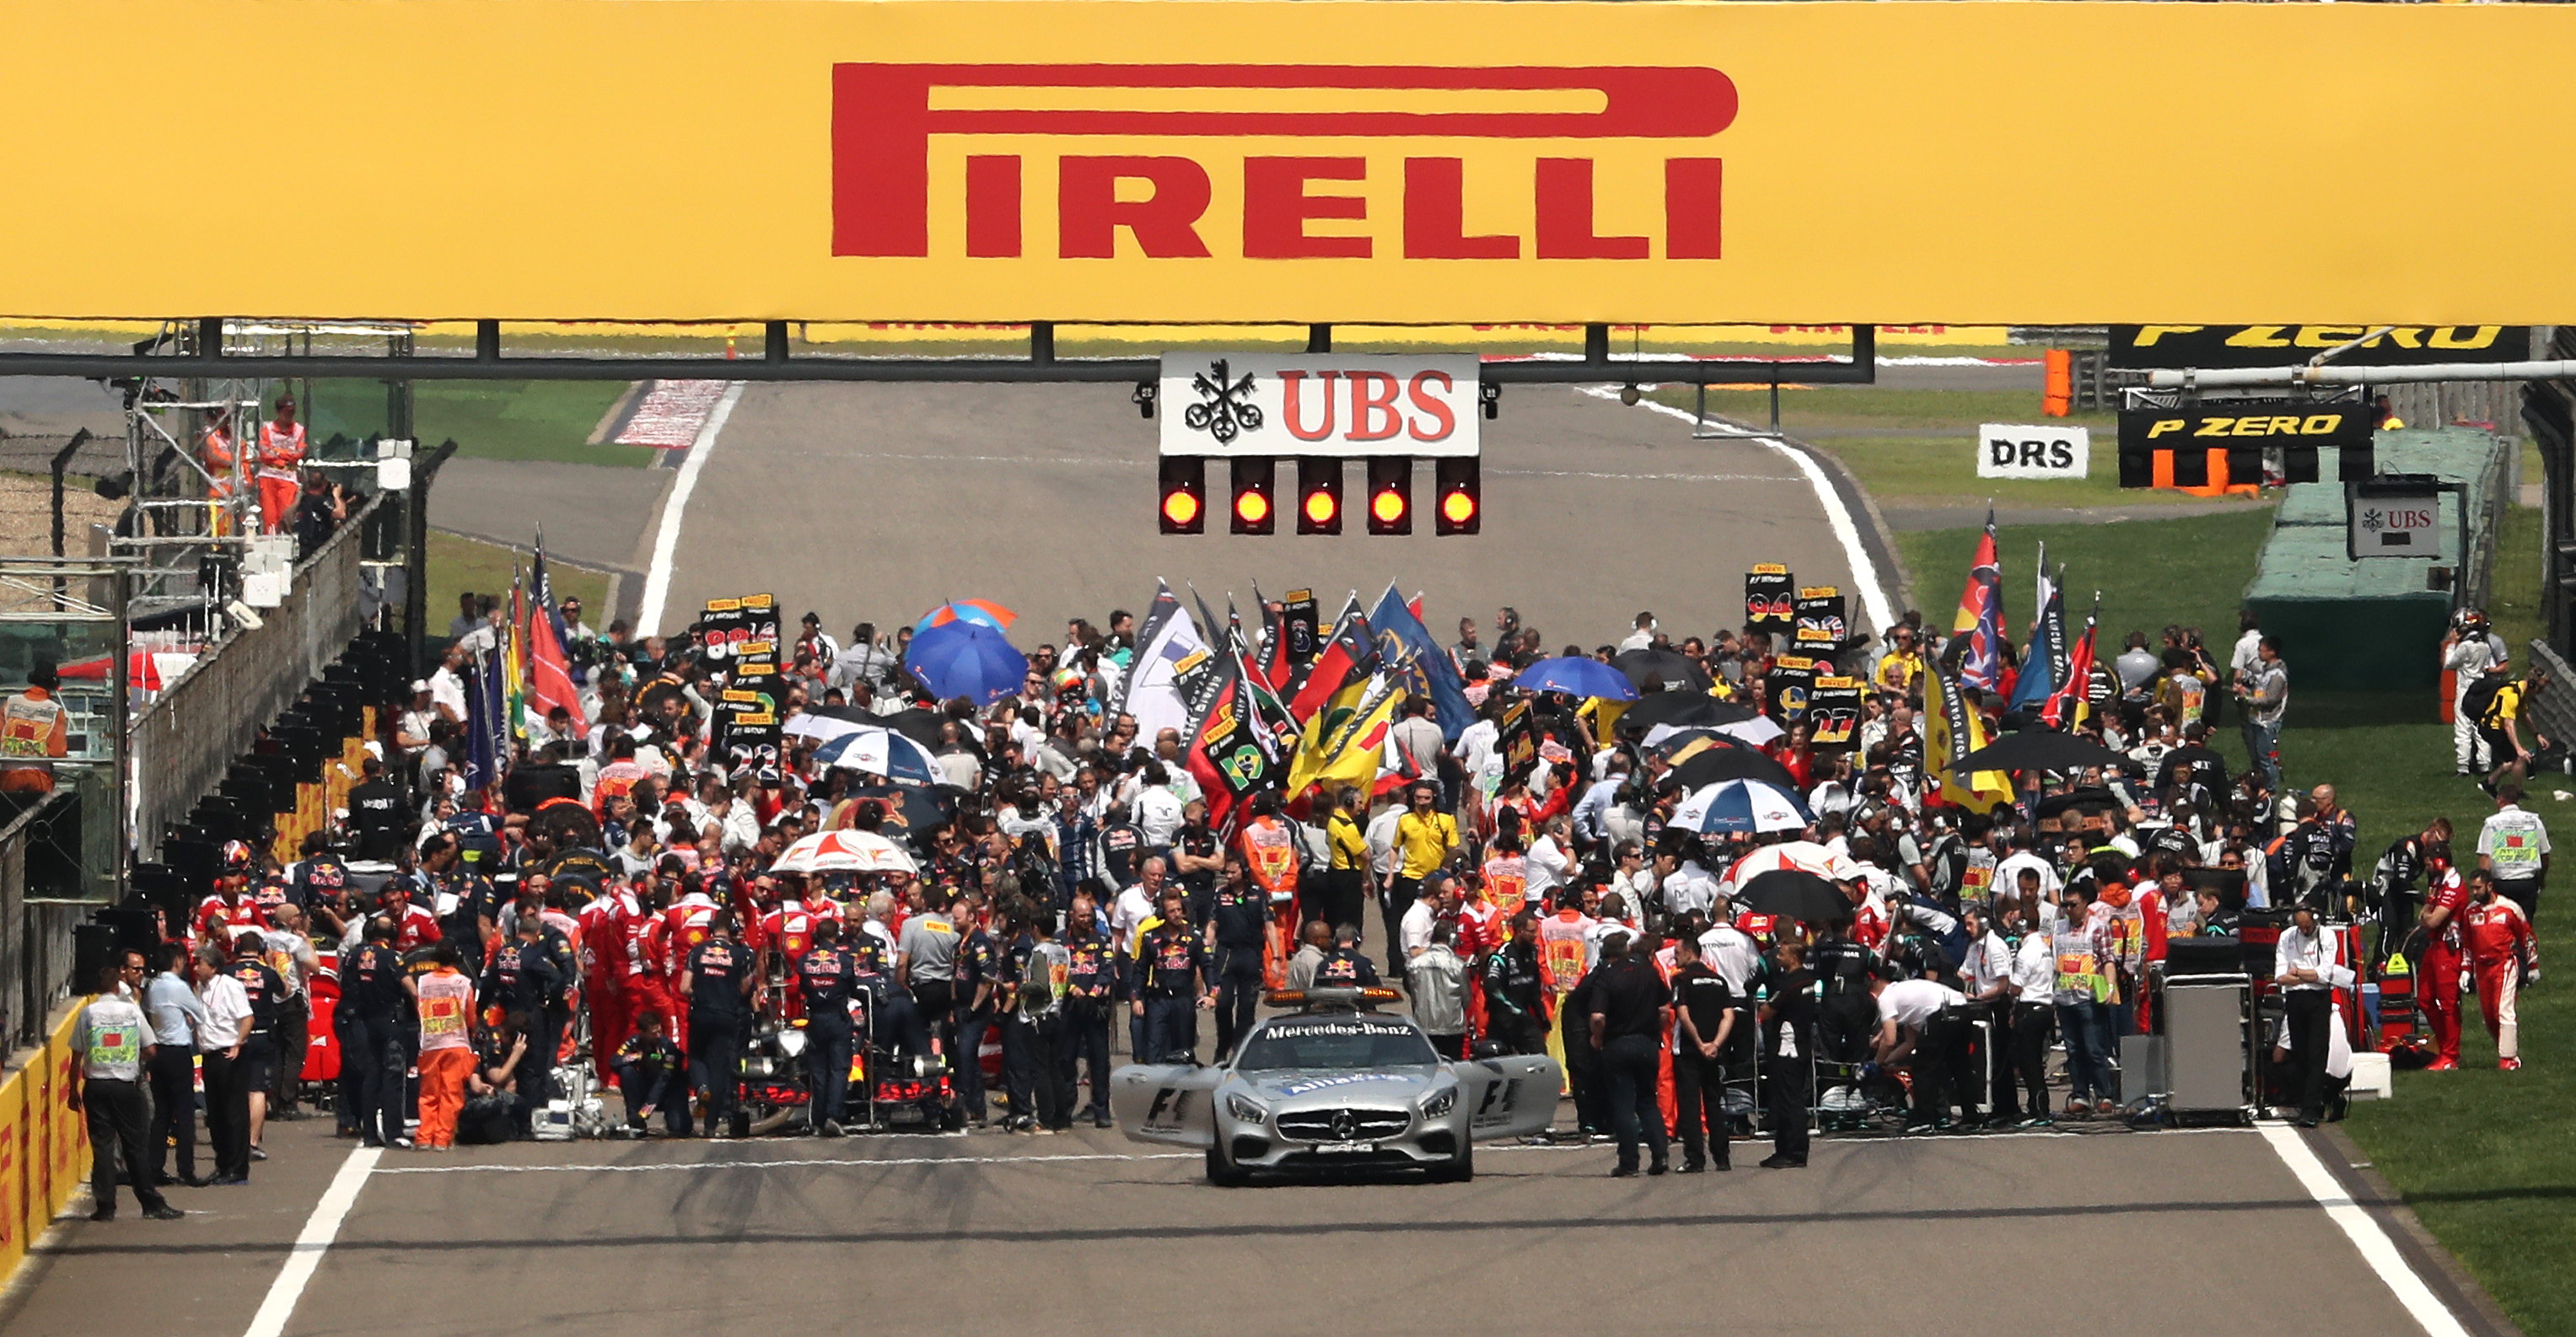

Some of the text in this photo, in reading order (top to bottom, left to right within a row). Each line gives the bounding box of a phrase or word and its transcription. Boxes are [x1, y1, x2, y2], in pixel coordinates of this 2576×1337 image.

[831, 63, 1738, 260] PIRELLI
[2224, 325, 2501, 349] ZERO
[1276, 369, 1455, 441] UBS
[2148, 414, 2342, 439] P ZERO
[1991, 439, 2073, 470] DRS
[2388, 510, 2432, 529] UBS
[1747, 592, 1794, 622] 94
[1778, 685, 1807, 721] 9
[1810, 707, 1859, 742] 27
[729, 743, 780, 781] 22
[1507, 730, 1535, 767] 14
[1219, 744, 1264, 792] 19
[1266, 1022, 1412, 1040] Mercedes-Benz
